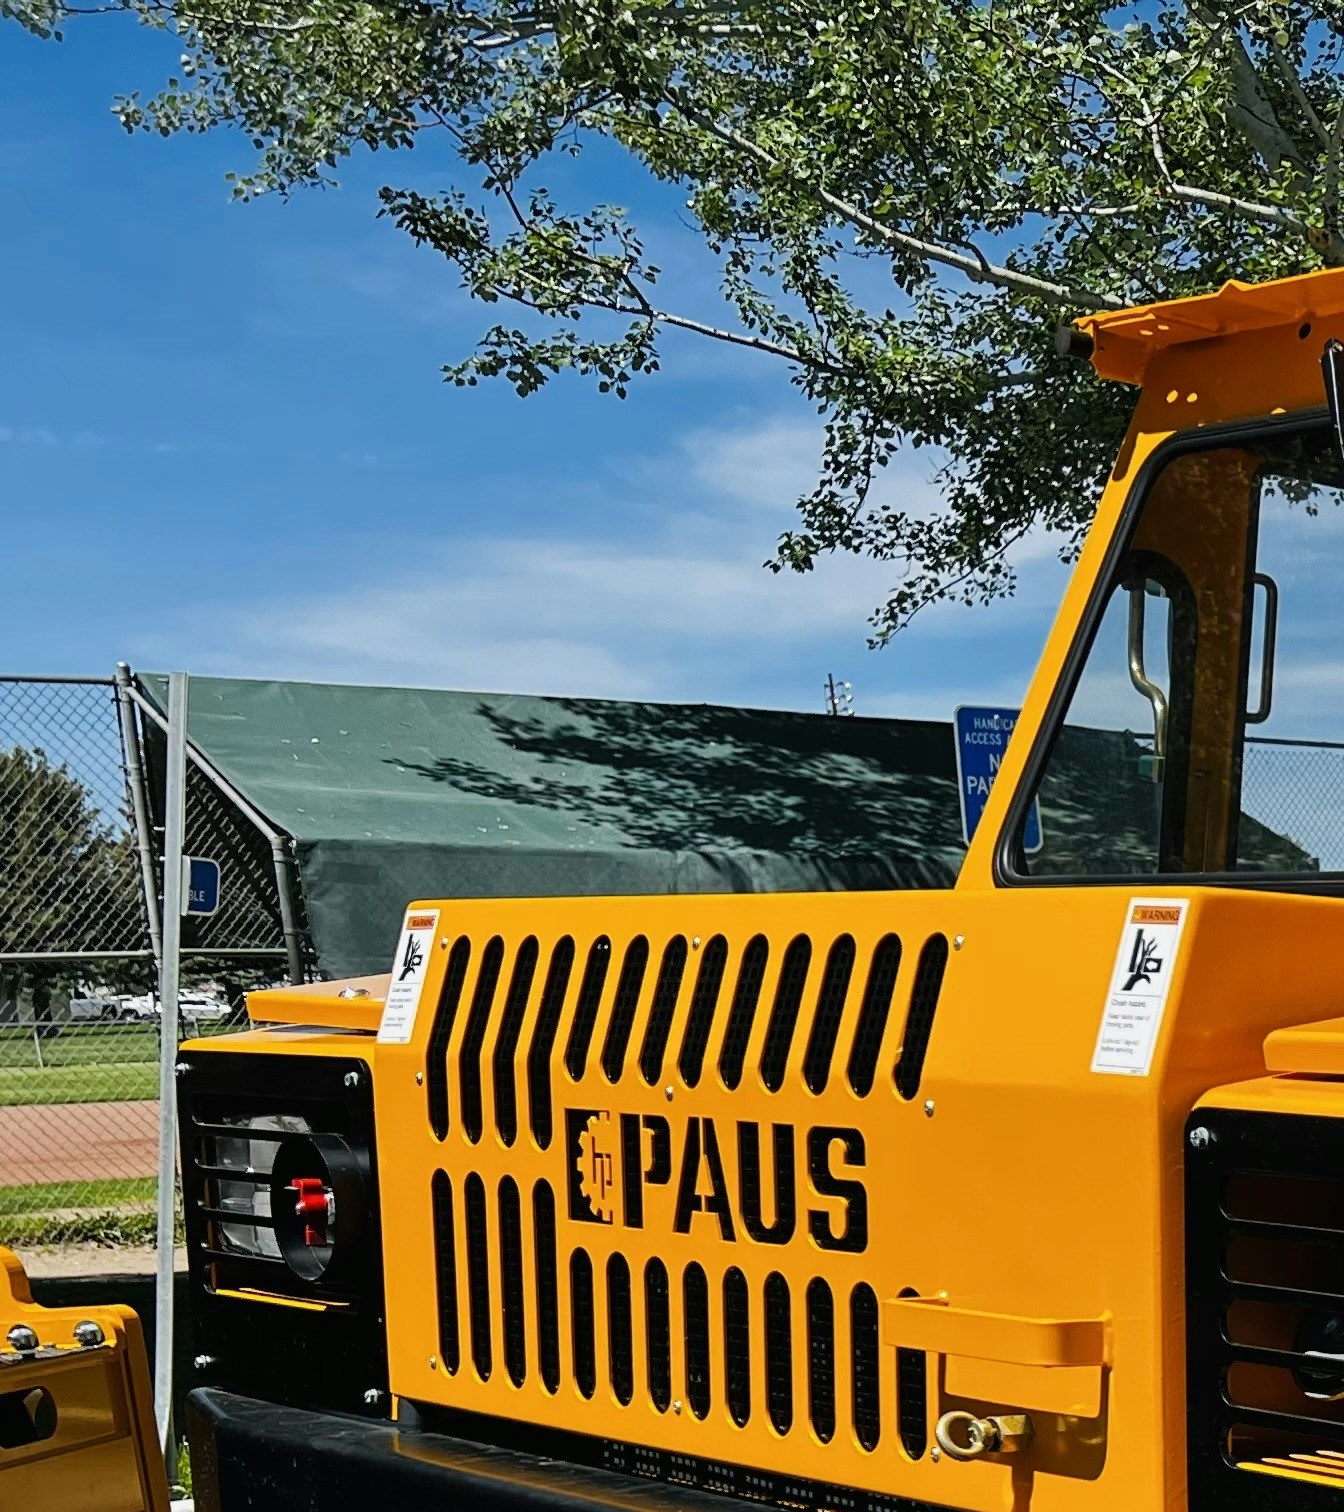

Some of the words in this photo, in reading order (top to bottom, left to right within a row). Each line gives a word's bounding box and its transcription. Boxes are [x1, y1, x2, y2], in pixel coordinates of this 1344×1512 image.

[965, 732, 1002, 746] ACCESS
[1141, 909, 1180, 921] WARNING
[619, 1112, 869, 1255] PAUS
